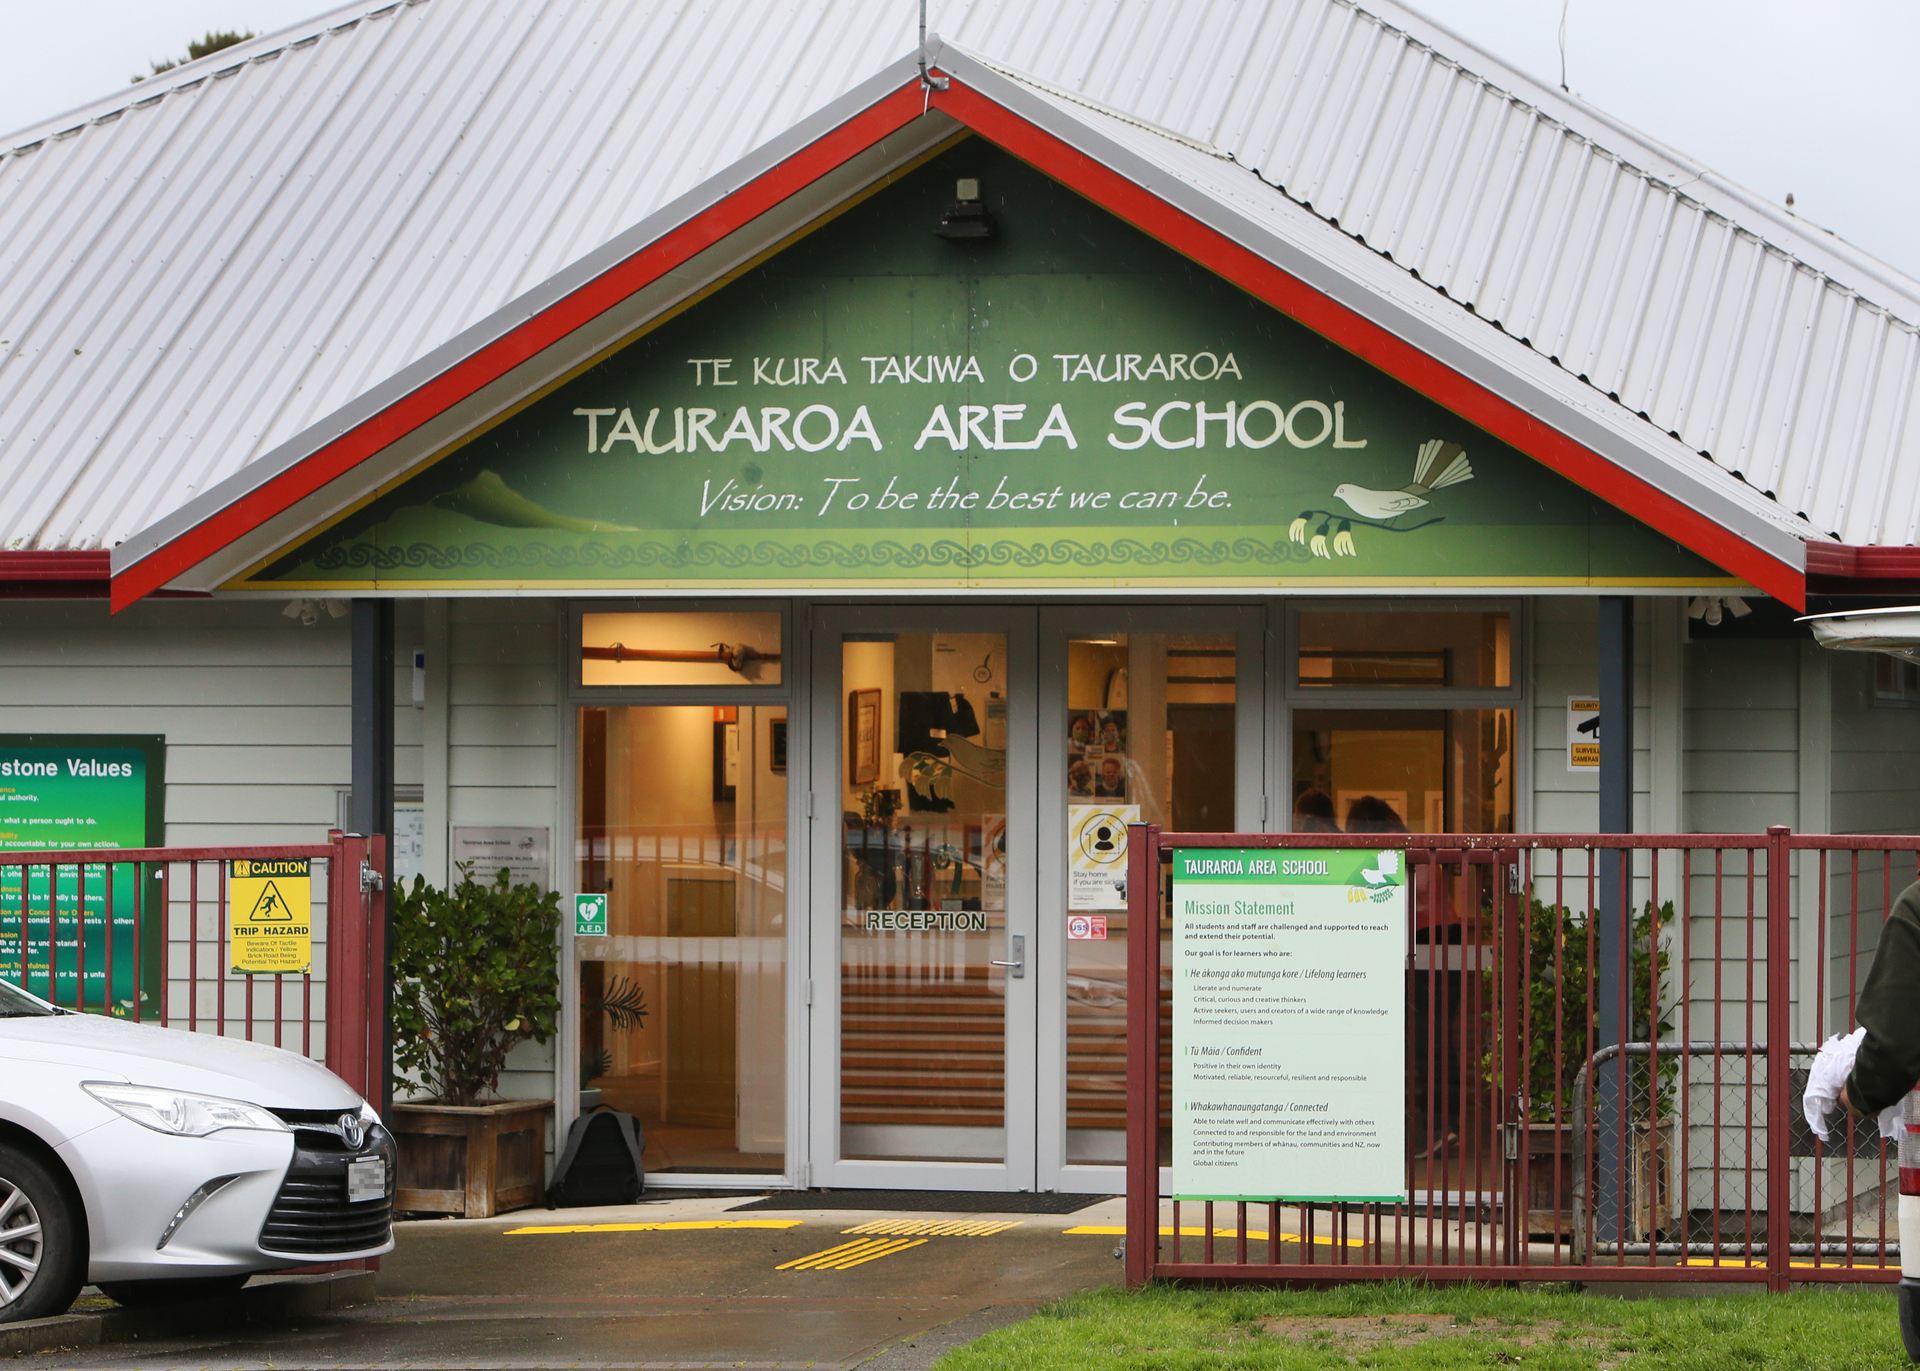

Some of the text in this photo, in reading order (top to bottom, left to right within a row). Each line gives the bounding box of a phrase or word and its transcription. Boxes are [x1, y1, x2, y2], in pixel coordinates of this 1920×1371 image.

[688, 348, 1242, 386] TE KURA TAKIWA O TAURAROA
[572, 400, 1367, 455] TAURAROA AREA SCHOOL
[700, 478, 804, 517] Vision:
[875, 475, 919, 510] be
[926, 476, 980, 510] the
[985, 475, 1064, 510] best
[1069, 491, 1112, 509] we
[1119, 491, 1178, 510] can
[1183, 474, 1232, 508] be.
[67, 759, 132, 777] Values
[251, 862, 307, 874] CAUTION
[1184, 860, 1329, 874] TAURAROA AREA SCHOOL
[1185, 900, 1295, 915] Mission Statement
[867, 912, 986, 930] RECEPTION
[234, 926, 309, 936] TRIP HAZARD
[1270, 923, 1308, 932] challenged
[1324, 924, 1360, 932] supported
[1242, 933, 1276, 941] potential.
[1198, 950, 1214, 958] goal
[1190, 968, 1201, 978] He
[1231, 968, 1245, 978] ako
[1246, 970, 1281, 981] mutunga
[1282, 968, 1299, 978] kore
[1304, 968, 1335, 981] Lifelong
[1336, 969, 1366, 979] learners
[1353, 1008, 1388, 1016] knowledge
[1226, 1046, 1262, 1056] Confident
[1190, 1102, 1329, 1114] Whakawhanaungatanga Connected
[1306, 1118, 1338, 1126] effectively
[1192, 1140, 1233, 1149] Contributing
